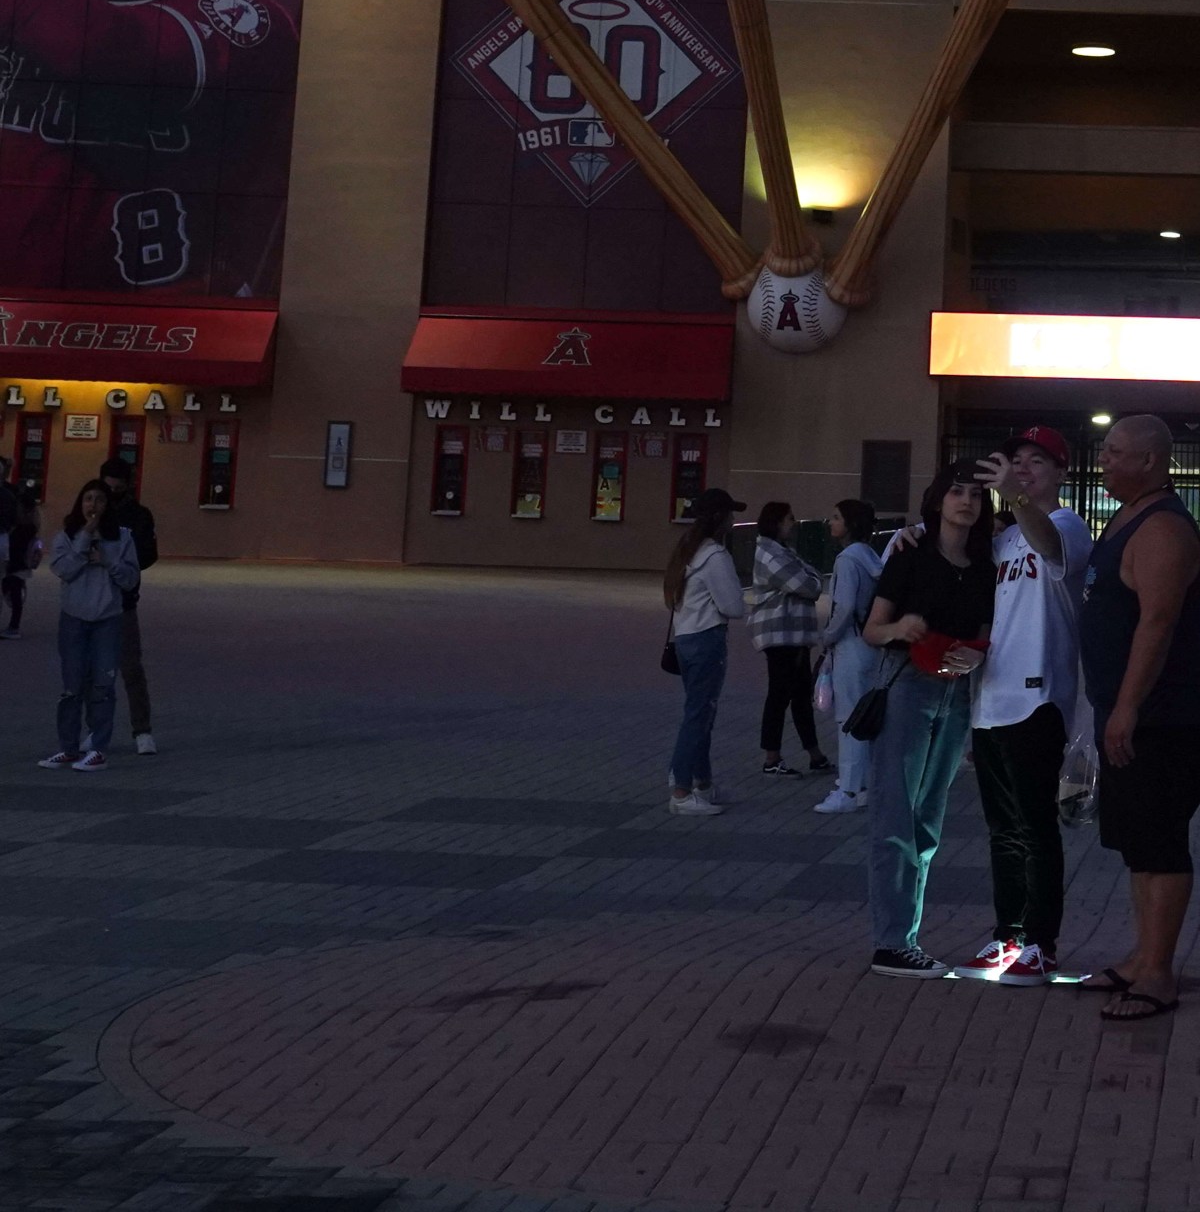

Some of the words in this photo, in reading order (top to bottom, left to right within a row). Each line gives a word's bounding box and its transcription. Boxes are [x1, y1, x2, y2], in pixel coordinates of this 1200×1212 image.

[467, 30, 510, 70] ANGELS
[660, 9, 728, 79] ANNIVERSARY
[517, 125, 562, 152] 1961
[110, 187, 191, 286] 8
[106, 388, 237, 413] CALL
[424, 398, 552, 422] WILL
[594, 404, 721, 427] CALL
